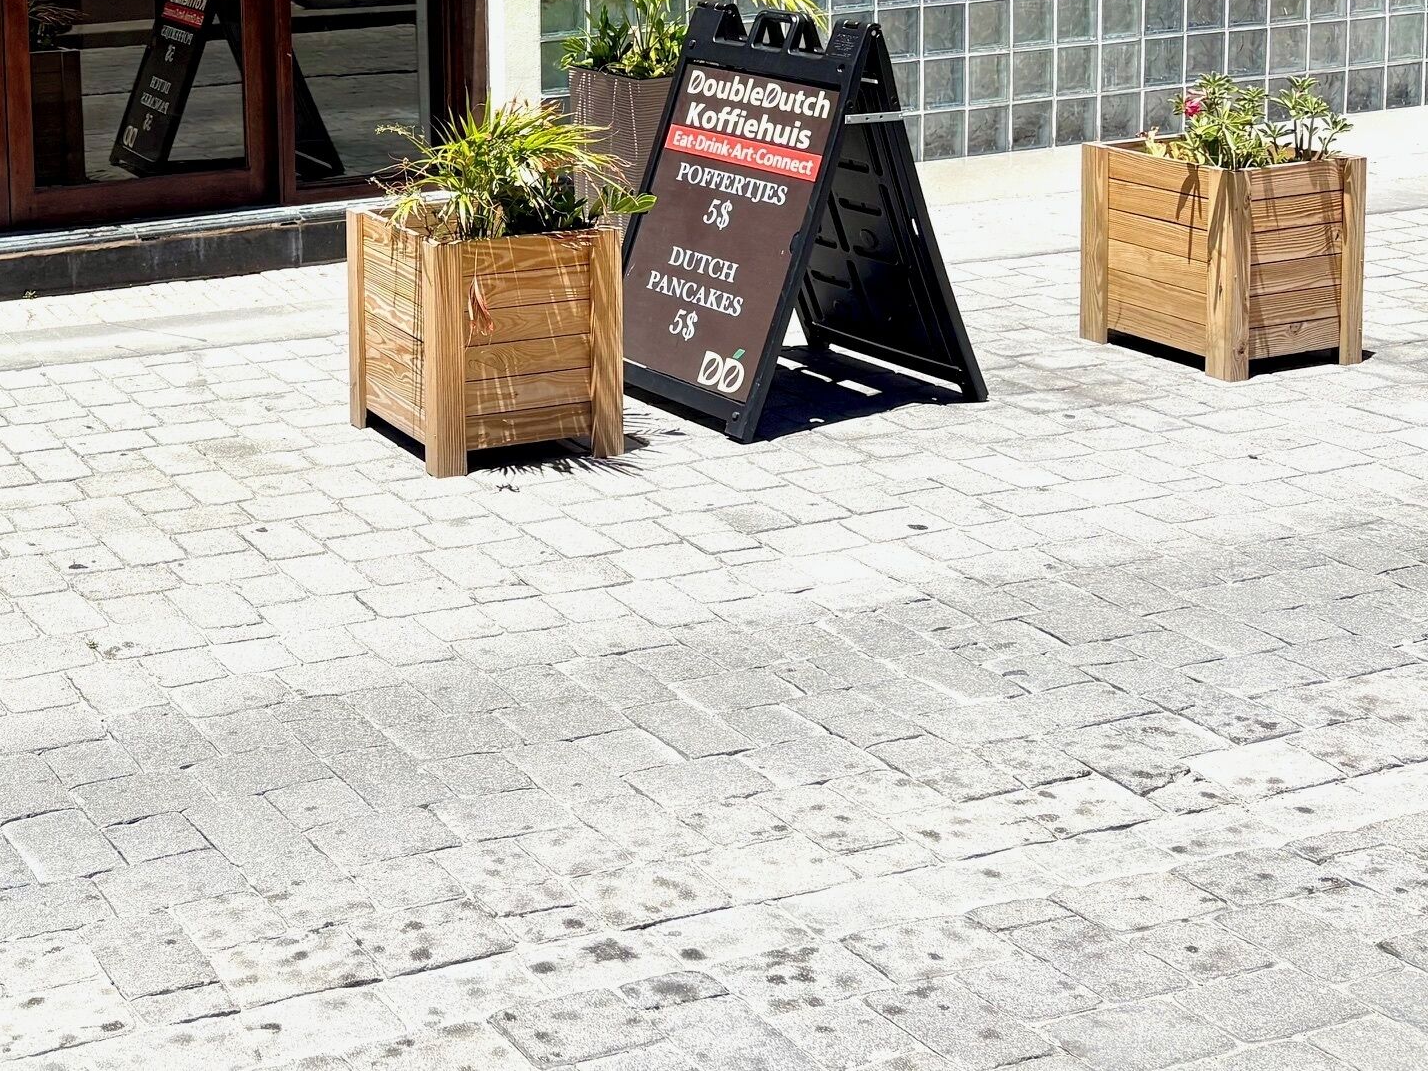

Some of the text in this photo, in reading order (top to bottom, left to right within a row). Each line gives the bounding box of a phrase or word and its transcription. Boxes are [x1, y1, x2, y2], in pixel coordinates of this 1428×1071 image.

[687, 69, 831, 119] DoubleDutch
[685, 101, 812, 149] Koffiehuis
[675, 161, 789, 206] POFFERTJES
[702, 198, 733, 231] 5$
[668, 245, 740, 283] DUTCH
[646, 270, 744, 318] PANCAKES
[668, 308, 699, 342] 5$
